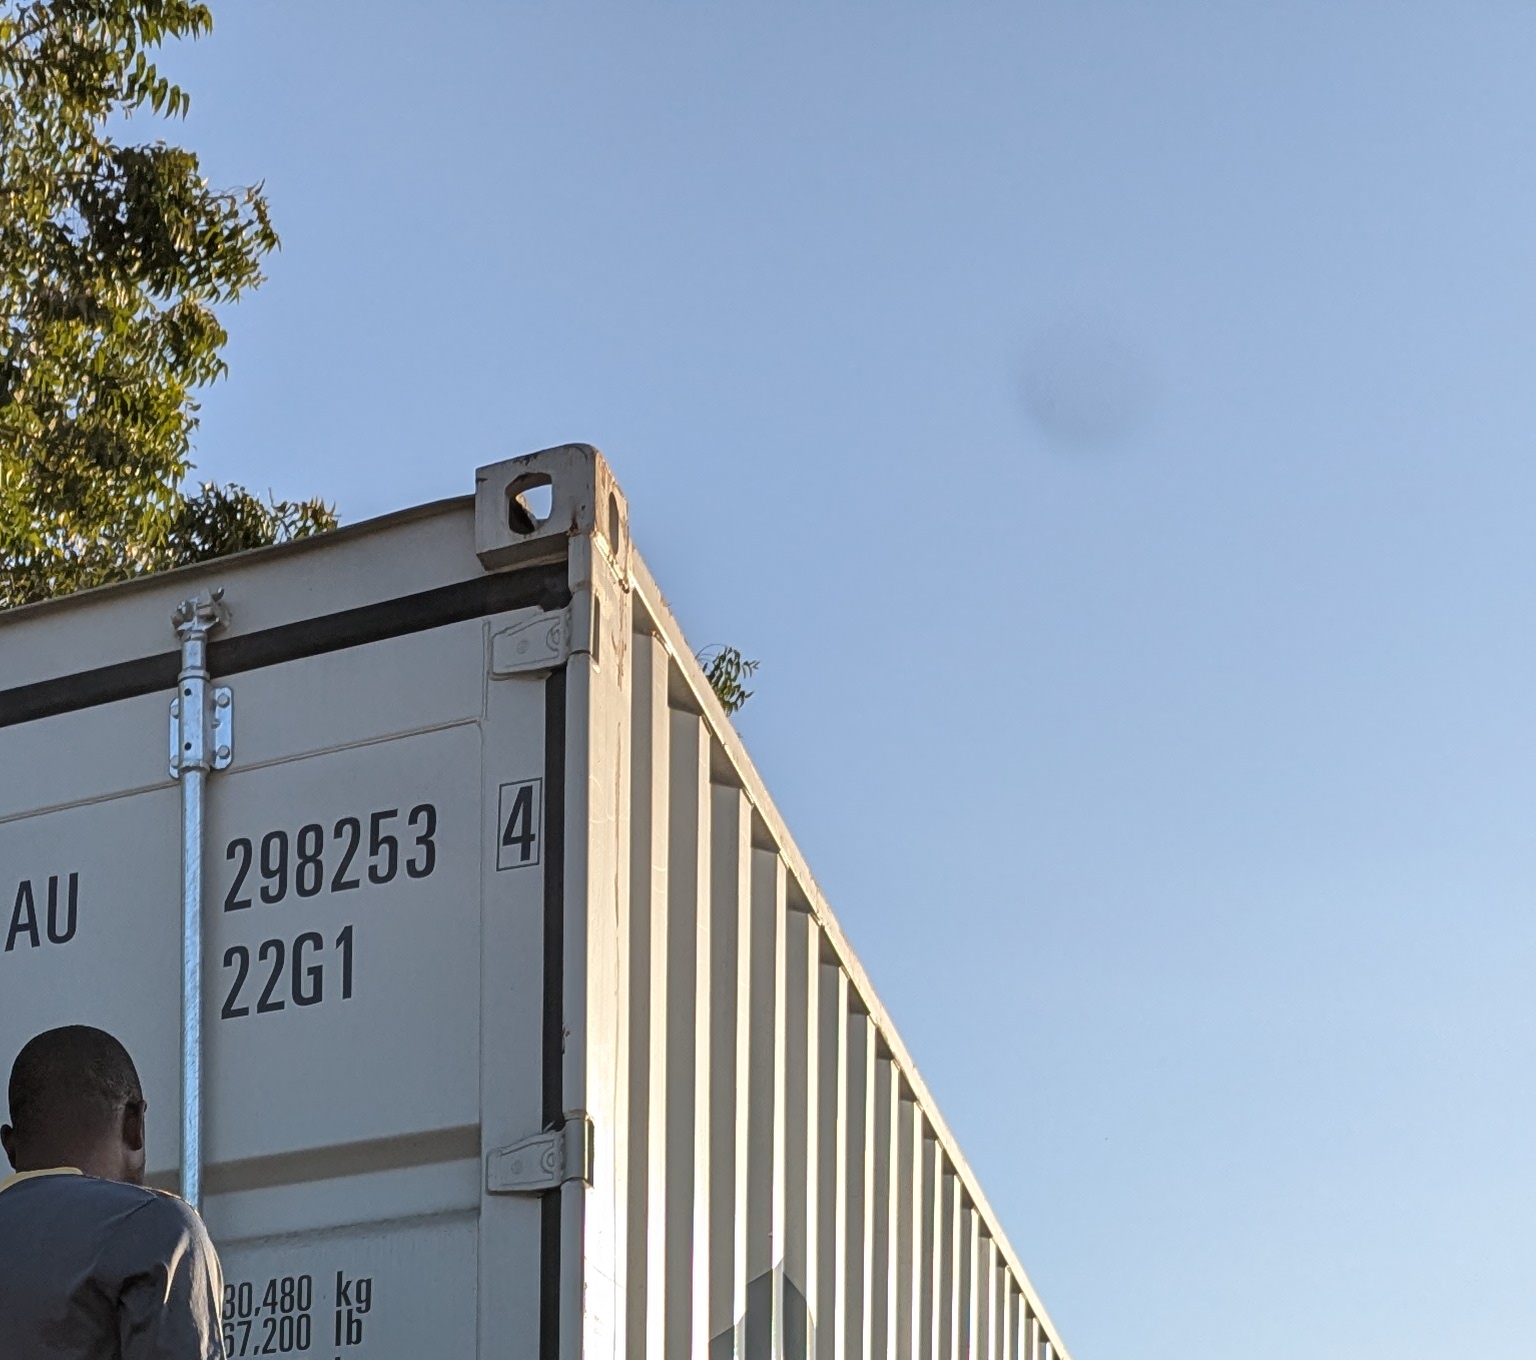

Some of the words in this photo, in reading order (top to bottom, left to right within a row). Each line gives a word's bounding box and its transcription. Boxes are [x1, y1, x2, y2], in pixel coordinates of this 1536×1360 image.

[224, 804, 437, 913] 298253
[502, 785, 536, 862] 4
[221, 925, 353, 1020] 22G1
[223, 1275, 312, 1320] 30,480
[336, 1271, 372, 1314] kg
[222, 1314, 311, 1358] 67,200
[335, 1309, 362, 1347] lb
